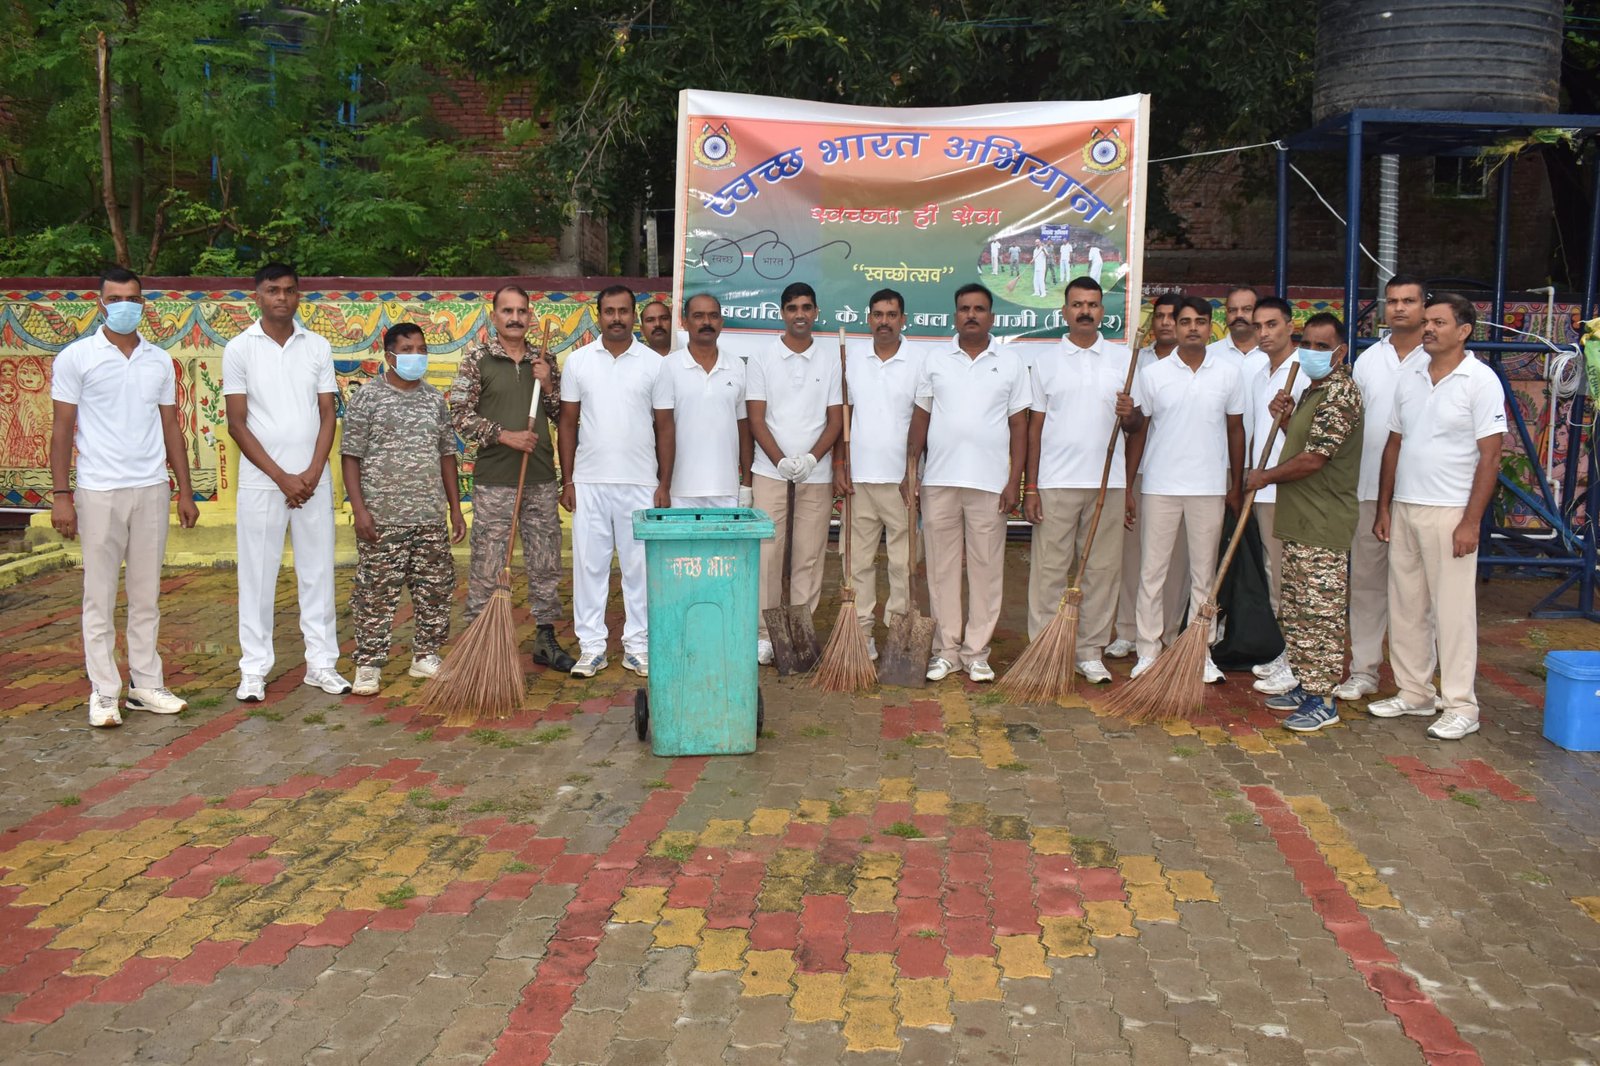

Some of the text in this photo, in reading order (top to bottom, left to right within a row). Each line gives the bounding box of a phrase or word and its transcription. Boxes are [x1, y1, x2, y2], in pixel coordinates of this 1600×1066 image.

[703, 132, 1113, 223] स्वच्छ भारत अभियान
[811, 206, 902, 225] स्वच्छता
[952, 205, 1002, 227] सेवा
